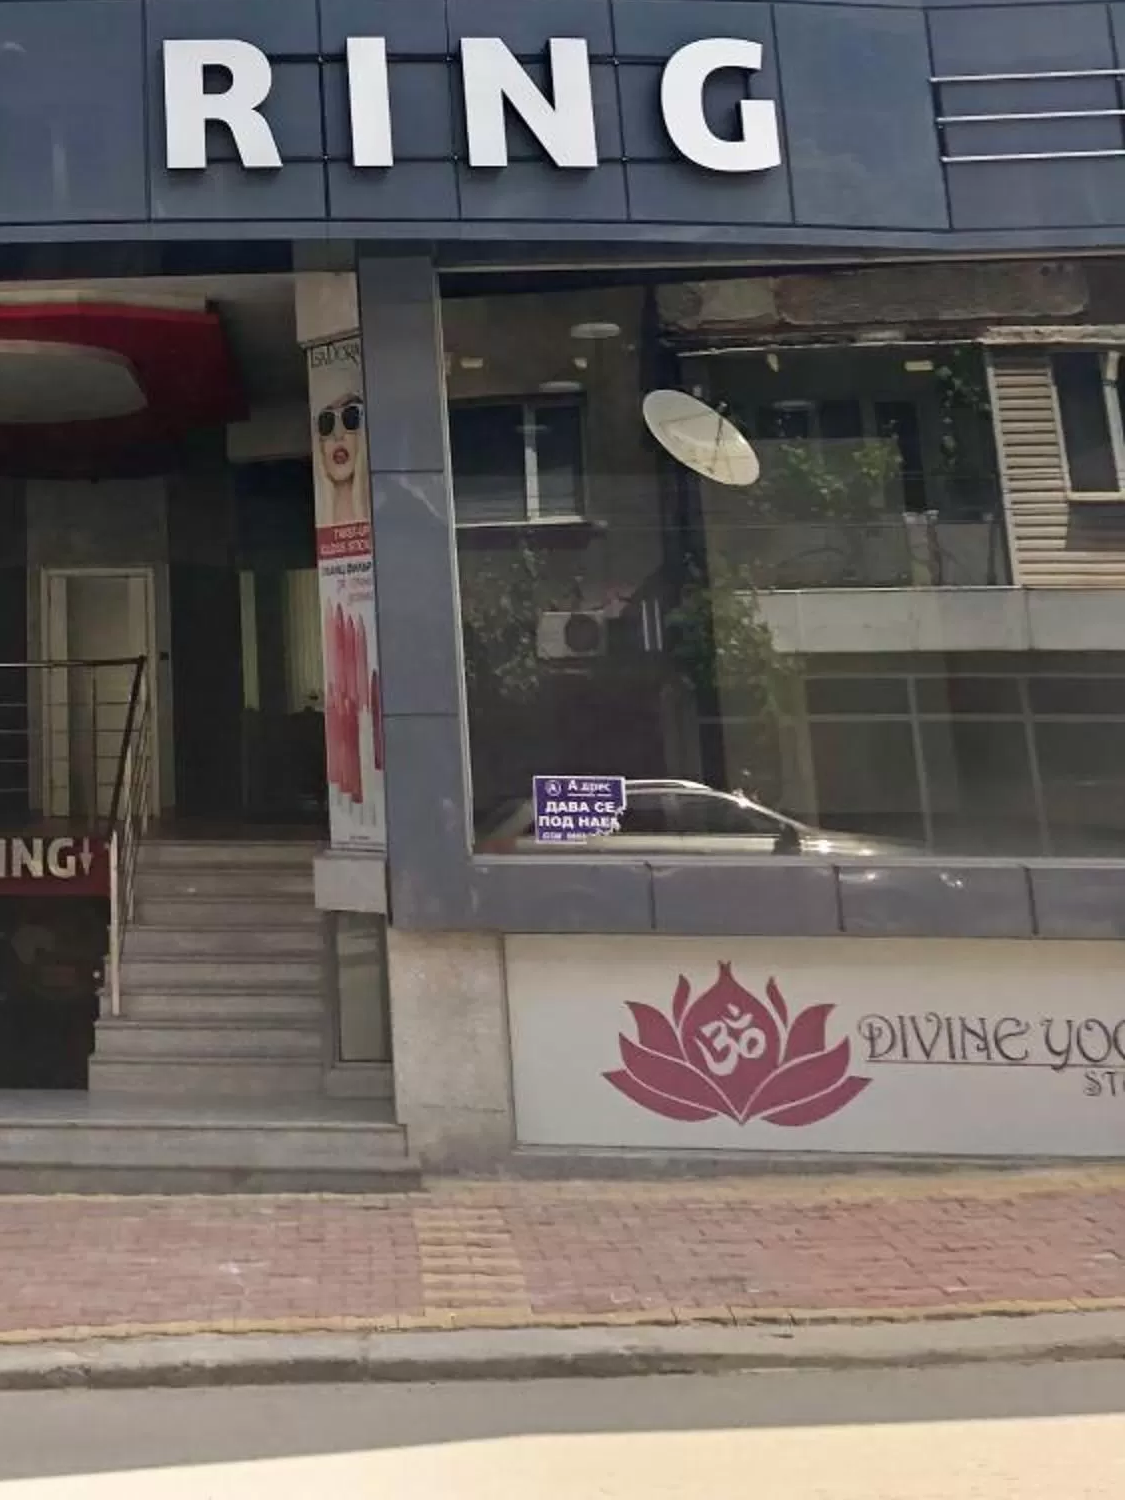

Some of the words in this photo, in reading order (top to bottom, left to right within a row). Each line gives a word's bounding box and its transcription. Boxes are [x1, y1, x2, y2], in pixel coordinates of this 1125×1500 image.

[162, 36, 782, 172] RING
[538, 815, 575, 829] ПОД
[545, 801, 591, 815] ДАВА
[594, 801, 616, 813] СЕ
[857, 1010, 1030, 1062] DIVINE
[1083, 1069, 1125, 1097] ST
